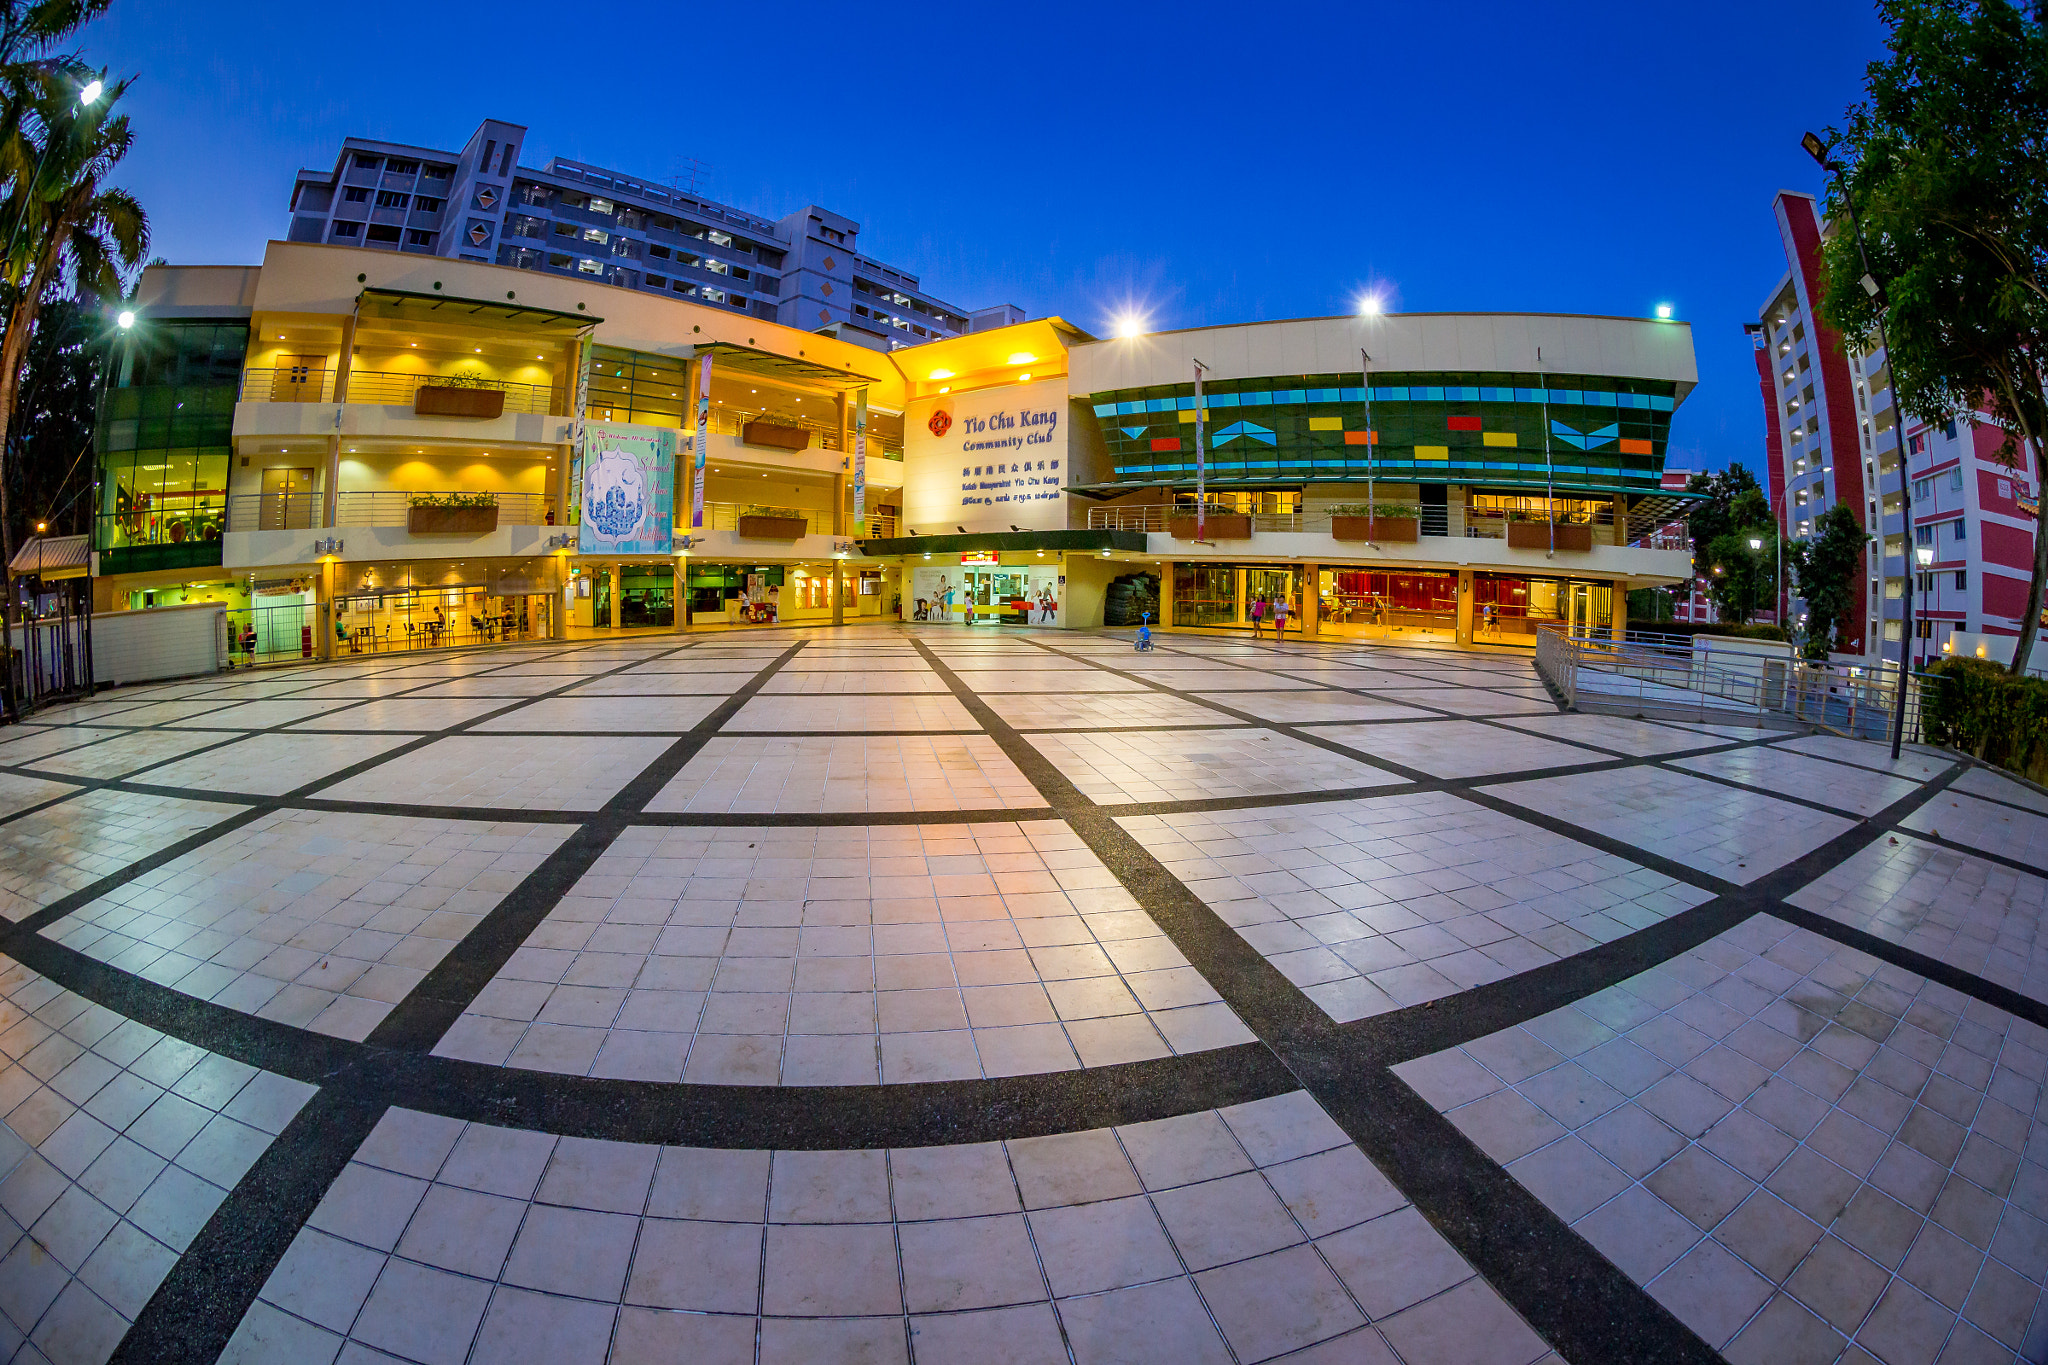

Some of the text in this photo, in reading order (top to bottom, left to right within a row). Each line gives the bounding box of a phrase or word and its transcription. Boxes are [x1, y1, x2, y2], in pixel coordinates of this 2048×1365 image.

[963, 410, 1057, 434] Yio Chu Kang
[963, 432, 1052, 451] Community Club
[1028, 477, 1040, 485] Chu
[1043, 476, 1059, 485] Kang
